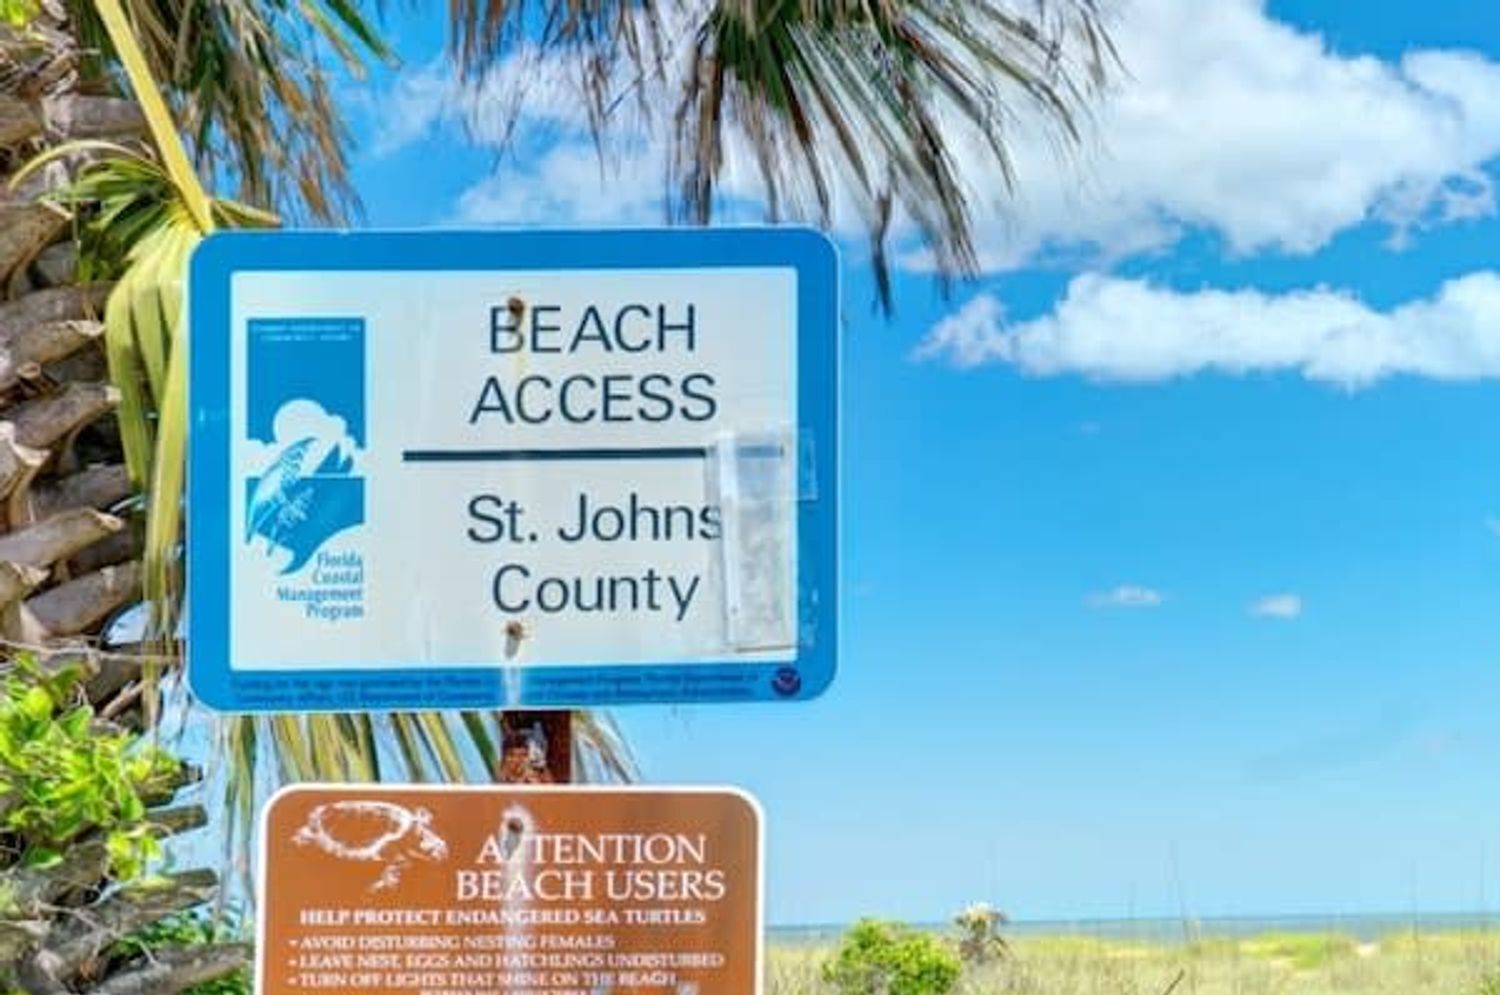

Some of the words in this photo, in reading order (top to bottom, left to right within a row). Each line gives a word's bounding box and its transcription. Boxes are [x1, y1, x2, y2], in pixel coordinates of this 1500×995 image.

[489, 303, 695, 354] BEACH
[468, 373, 718, 424] ACCESS
[466, 493, 538, 543] St.
[557, 493, 721, 543] Johns
[317, 550, 363, 566] Florida
[312, 567, 363, 584] Coastal
[277, 587, 363, 603] Management
[491, 564, 701, 621] County
[305, 603, 364, 621] Program
[475, 832, 707, 864] ATENTION
[456, 869, 594, 901] BEACH
[605, 869, 727, 901] USERS
[300, 909, 351, 926] HELP
[353, 909, 441, 926] PROTECT
[445, 909, 580, 926] ENDANGERED
[582, 909, 620, 926] SEA
[623, 909, 707, 926] TURTLES
[300, 935, 356, 949] AVOID
[358, 935, 461, 949] DISTURBING
[463, 935, 537, 949] NESTING
[539, 935, 616, 949] FEMALES
[299, 953, 354, 968] LEAVE
[405, 953, 450, 968] EGGS
[454, 953, 493, 968] AND
[495, 953, 604, 968] HATCHLINGS
[606, 953, 726, 968] UNDISTURBED
[300, 972, 347, 987] TURN
[349, 972, 383, 987] OFF
[385, 972, 447, 987] LIGHTS
[449, 972, 494, 987] THAT
[495, 972, 549, 987] SHINE
[552, 972, 580, 987] ON
[583, 972, 611, 987] THE
[618, 972, 678, 987] BEACH
